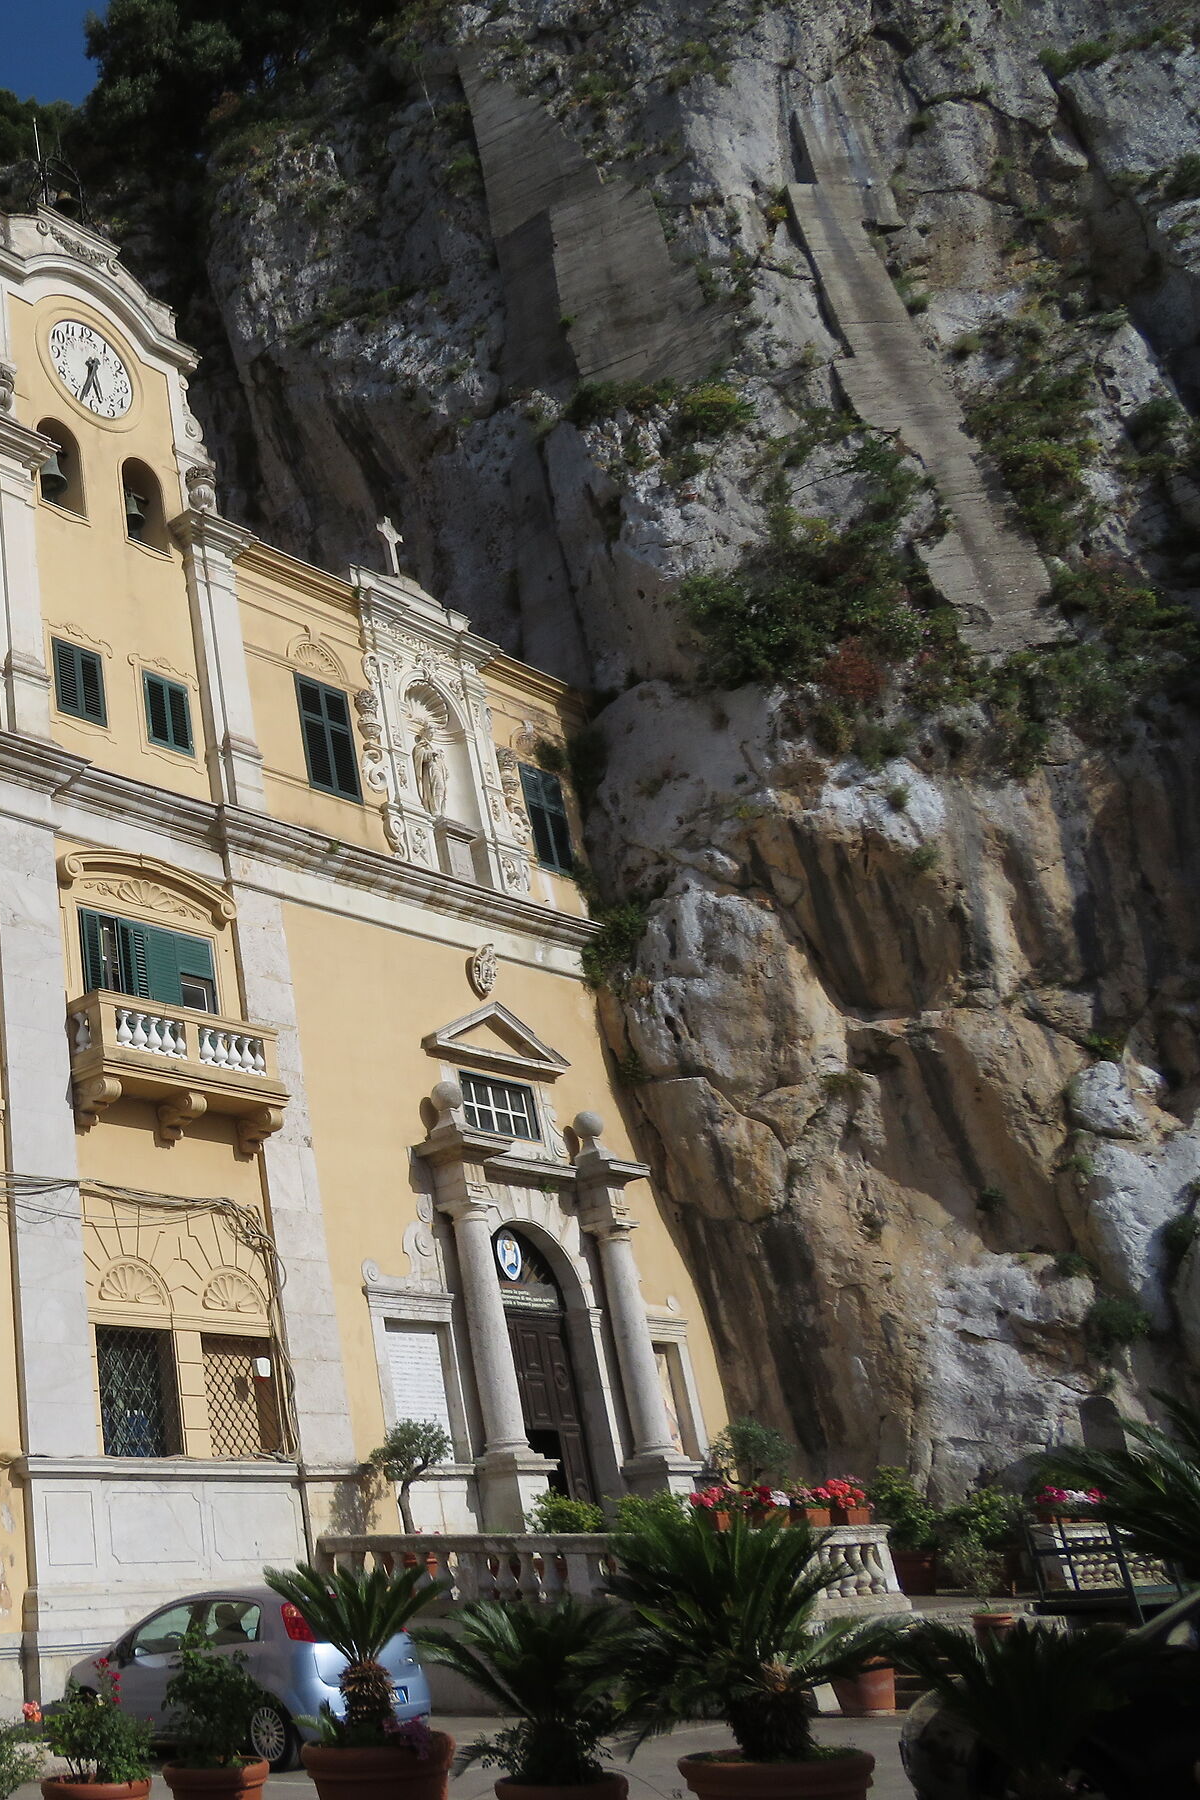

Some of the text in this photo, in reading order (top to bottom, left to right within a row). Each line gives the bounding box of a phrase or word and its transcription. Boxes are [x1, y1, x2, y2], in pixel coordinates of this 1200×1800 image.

[51, 328, 65, 344] 10
[65, 323, 75, 337] 11
[79, 327, 94, 342] 12
[51, 345, 60, 358] 9
[102, 343, 107, 354] 1
[58, 365, 67, 380] 8
[114, 360, 124, 375] 2
[71, 383, 80, 398] 7
[120, 380, 129, 394] 3
[89, 399, 99, 414] 6
[106, 403, 115, 417] 5
[116, 397, 126, 409] 4
